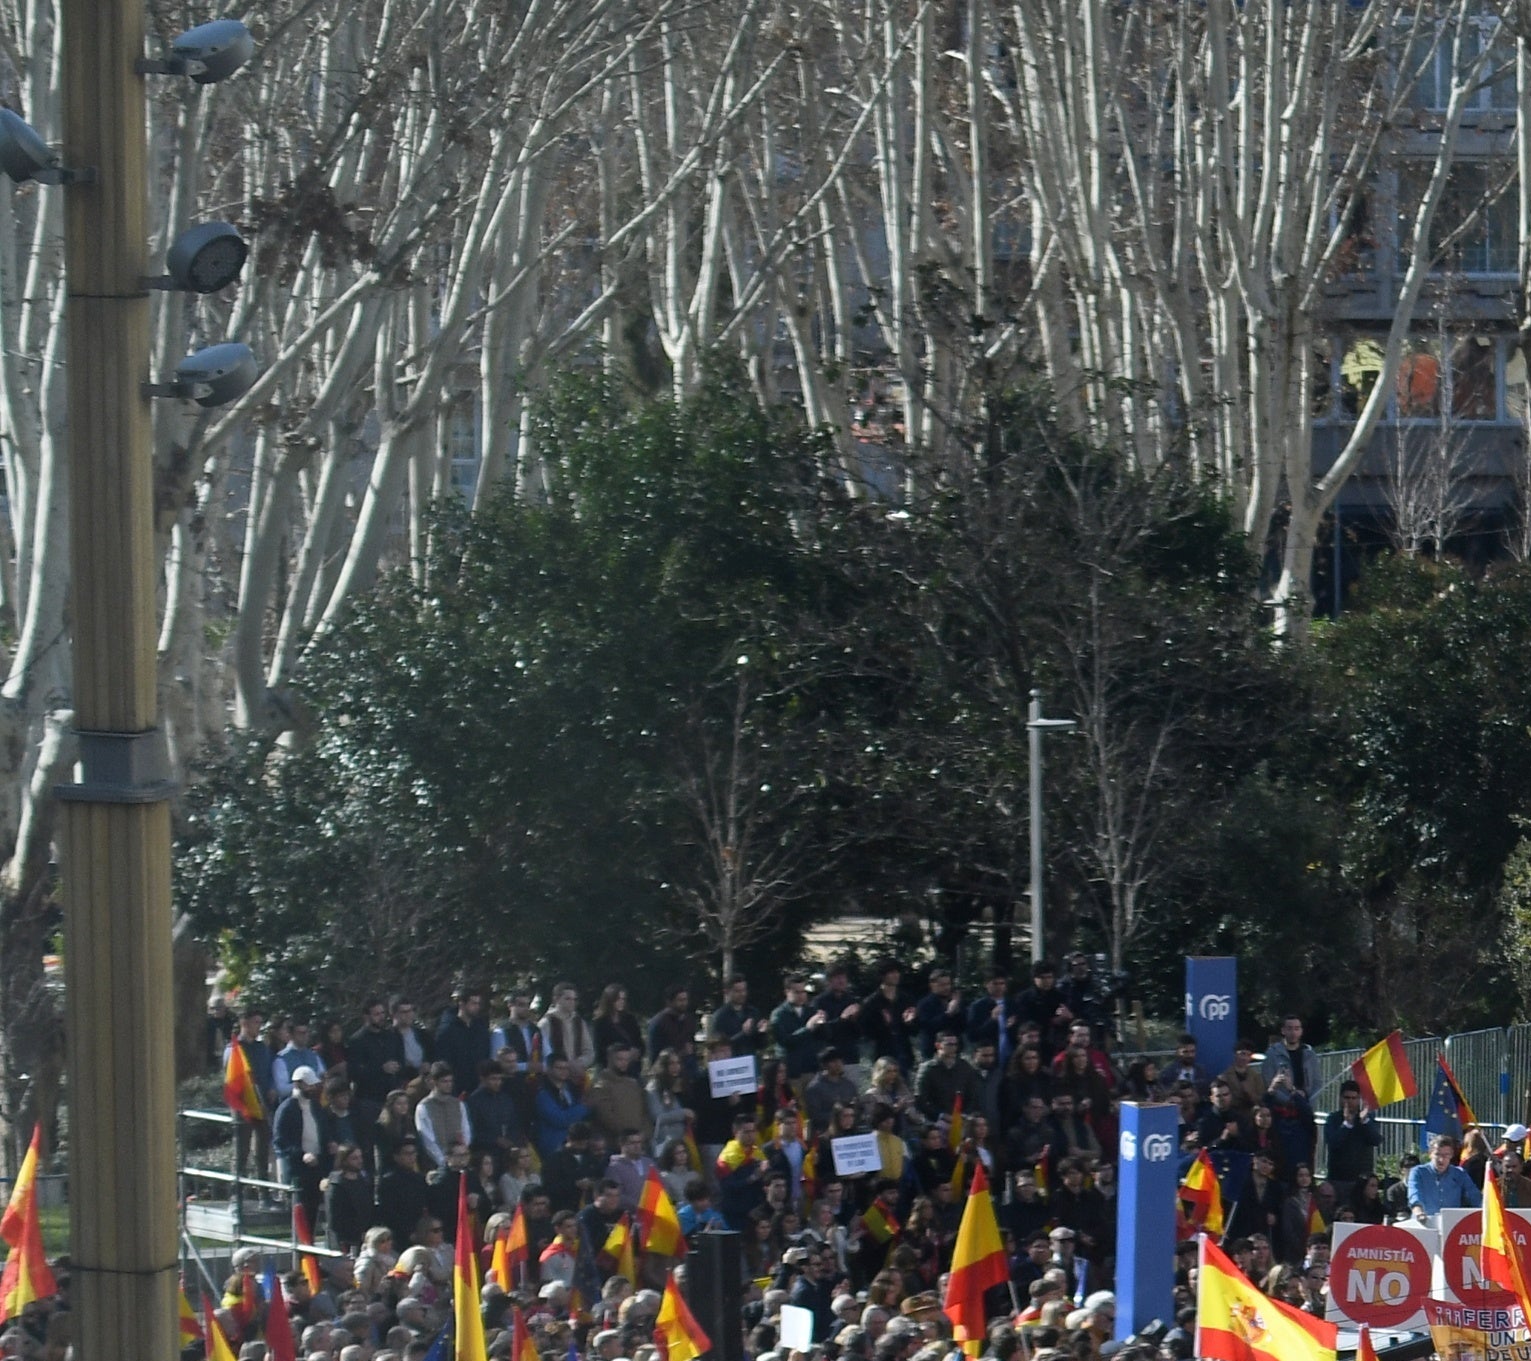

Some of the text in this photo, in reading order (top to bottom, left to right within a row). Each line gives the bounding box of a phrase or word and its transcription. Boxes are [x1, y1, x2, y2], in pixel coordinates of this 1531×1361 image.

[1347, 1244, 1414, 1263] AMNISTÍA
[1347, 1270, 1410, 1306] NO
[1489, 1331, 1516, 1347] UN
